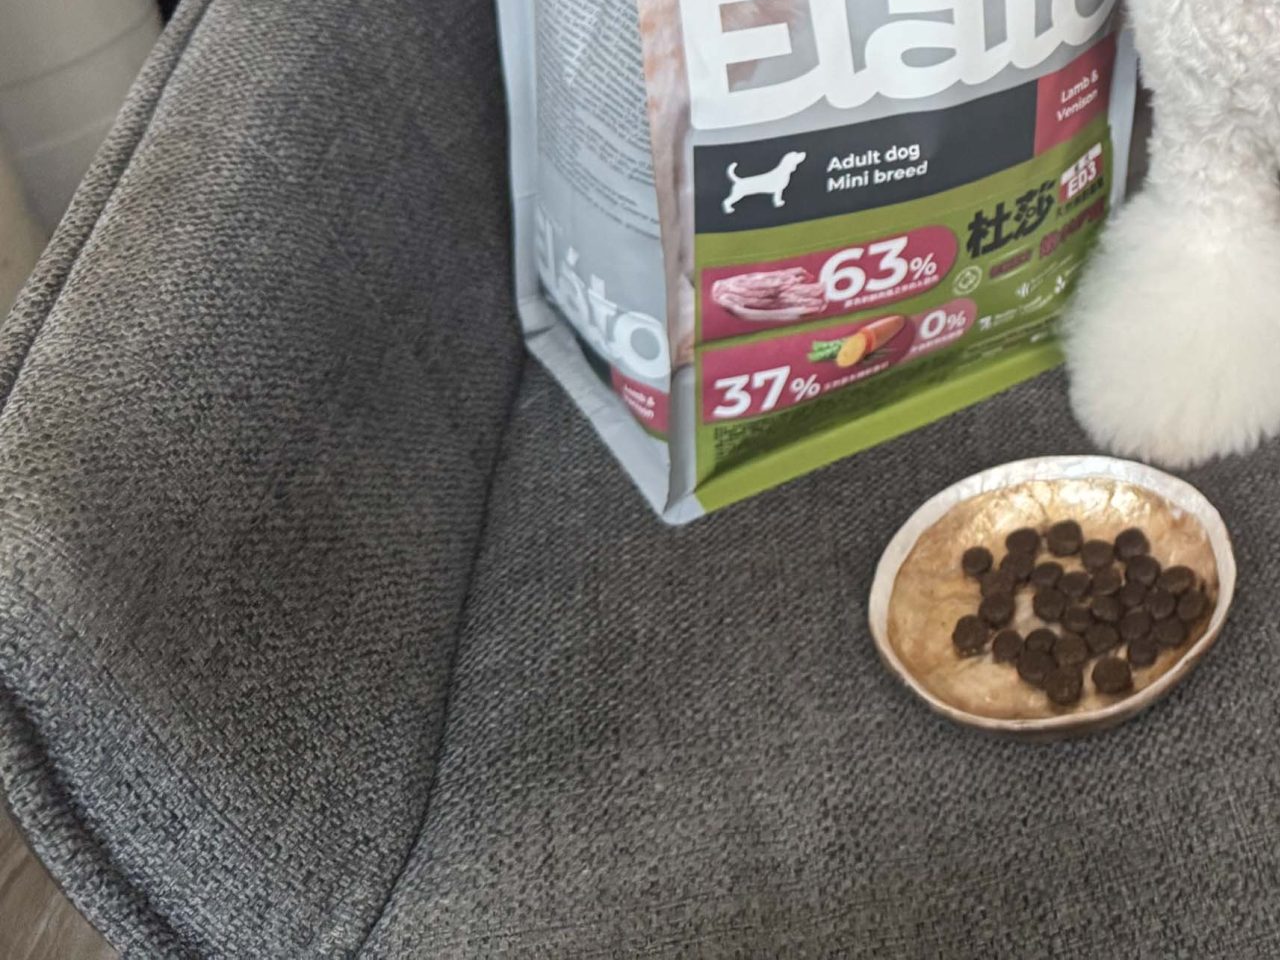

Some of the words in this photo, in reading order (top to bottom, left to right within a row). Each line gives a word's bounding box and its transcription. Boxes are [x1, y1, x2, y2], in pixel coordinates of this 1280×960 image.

[1055, 88, 1099, 122] Venison
[1061, 76, 1091, 104] Lamb
[826, 149, 882, 173] Adult
[884, 143, 921, 162] dog
[826, 170, 870, 193] Mini
[873, 160, 929, 185] breed
[819, 236, 938, 302] 63%
[919, 310, 968, 339] 0%
[712, 365, 821, 418] 37%
